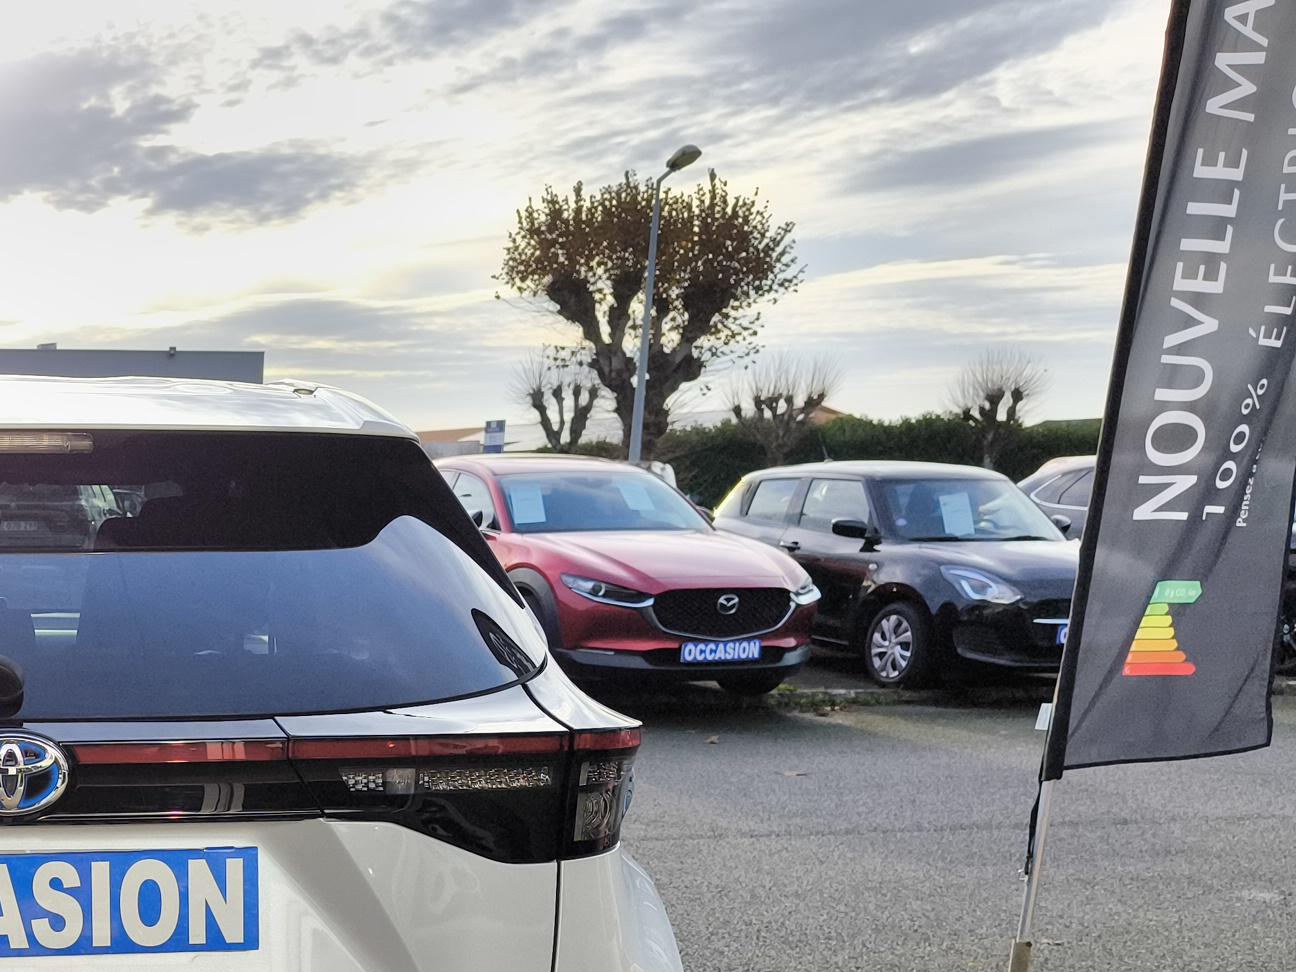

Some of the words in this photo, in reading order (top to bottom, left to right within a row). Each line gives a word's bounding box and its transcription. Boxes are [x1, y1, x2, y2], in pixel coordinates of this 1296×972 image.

[1133, 148, 1247, 520] NOUVELLE
[1205, 0, 1276, 122] MA
[1202, 378, 1268, 520] 100%
[1236, 477, 1254, 526] Pensez
[684, 640, 760, 661] OCCASION
